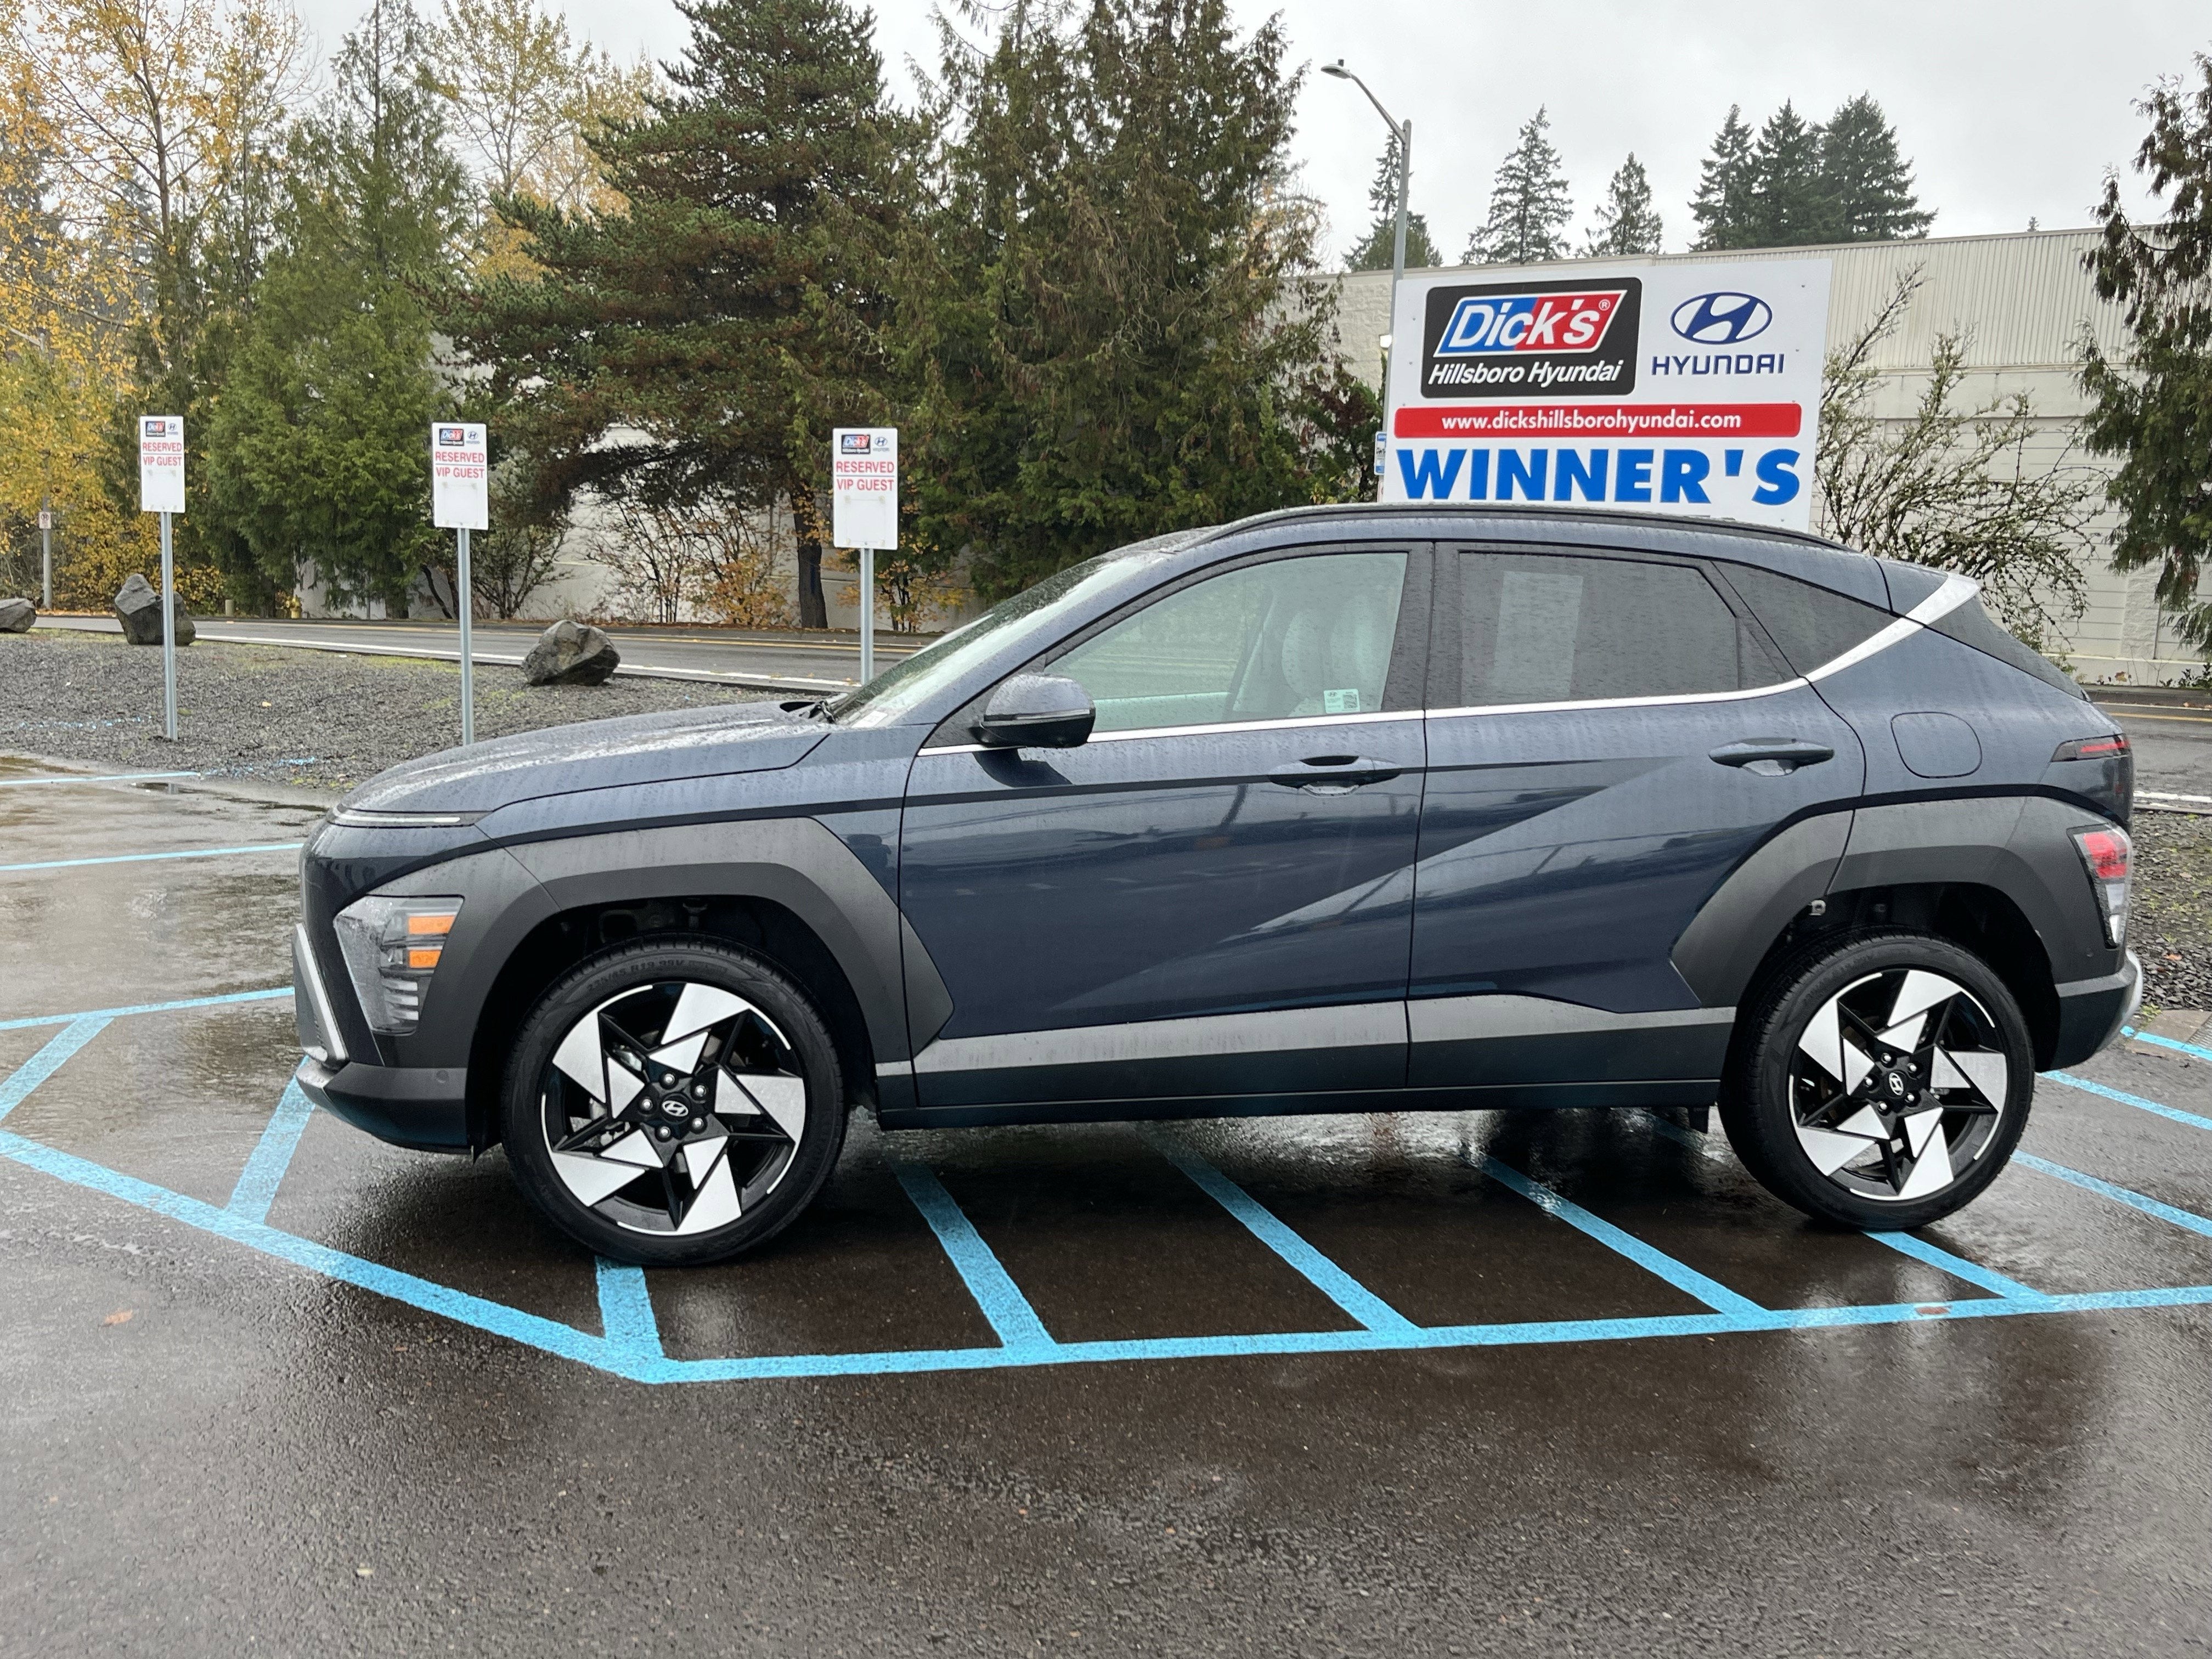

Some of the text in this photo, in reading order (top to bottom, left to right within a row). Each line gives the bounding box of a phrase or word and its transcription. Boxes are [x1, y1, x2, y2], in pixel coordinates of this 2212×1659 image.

[1652, 354, 1785, 375] HYUNDAI
[1429, 359, 1624, 388] Hillsboro Hyundai
[1442, 408, 1741, 432] www.dickshillsborohyundai.com
[142, 442, 182, 452] RESERVED
[143, 456, 182, 466] VIP GUEST
[435, 451, 484, 463] RESERVED
[436, 466, 484, 478] VIP GUEST
[836, 461, 895, 473] RESERVED
[1397, 448, 1800, 506] WINNER'S
[837, 478, 894, 491] VIP GUEST
